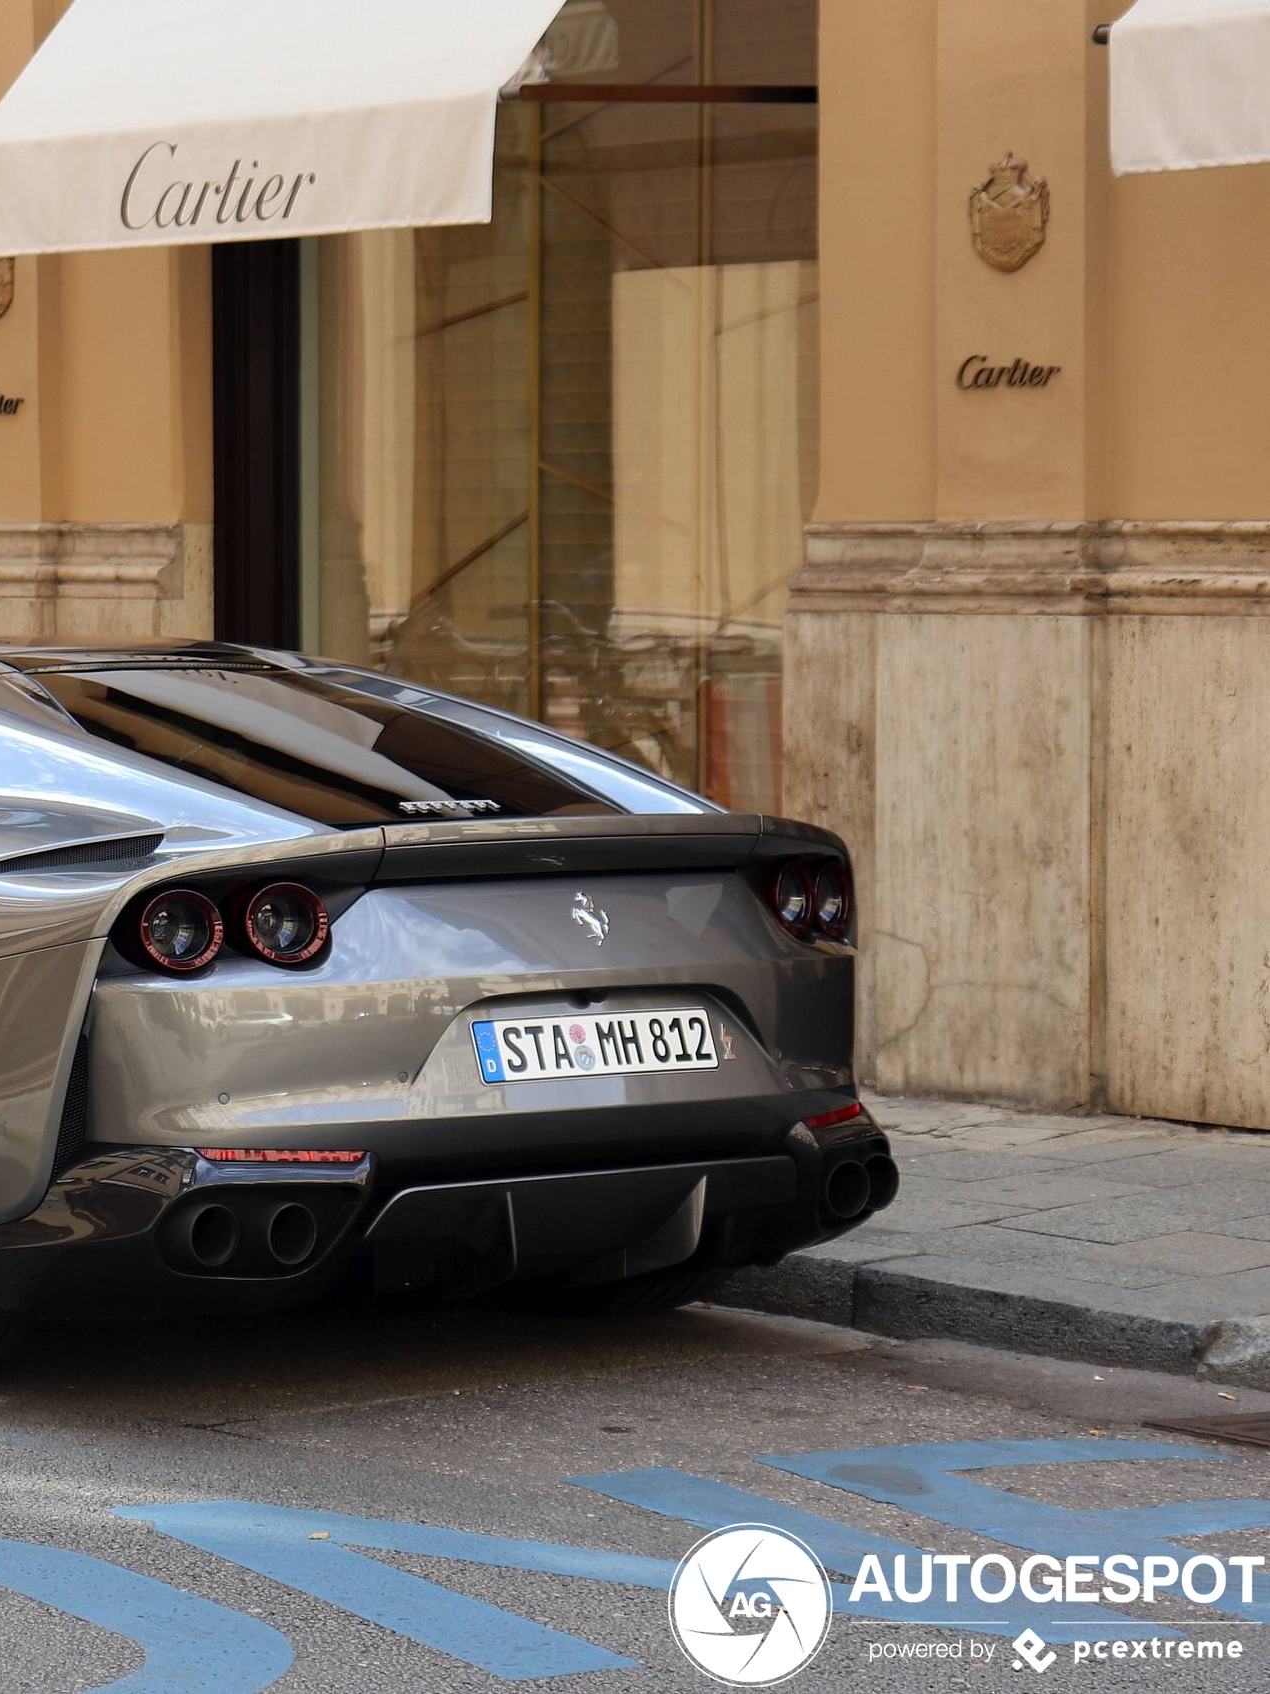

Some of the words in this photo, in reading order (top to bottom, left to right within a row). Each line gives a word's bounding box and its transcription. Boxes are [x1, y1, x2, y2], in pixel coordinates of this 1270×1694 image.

[120, 141, 316, 229] Cartier
[956, 355, 1061, 390] Cartier
[486, 1059, 497, 1073] D
[502, 1025, 575, 1073] STA
[595, 1019, 645, 1066] MH
[648, 1016, 713, 1063] 812
